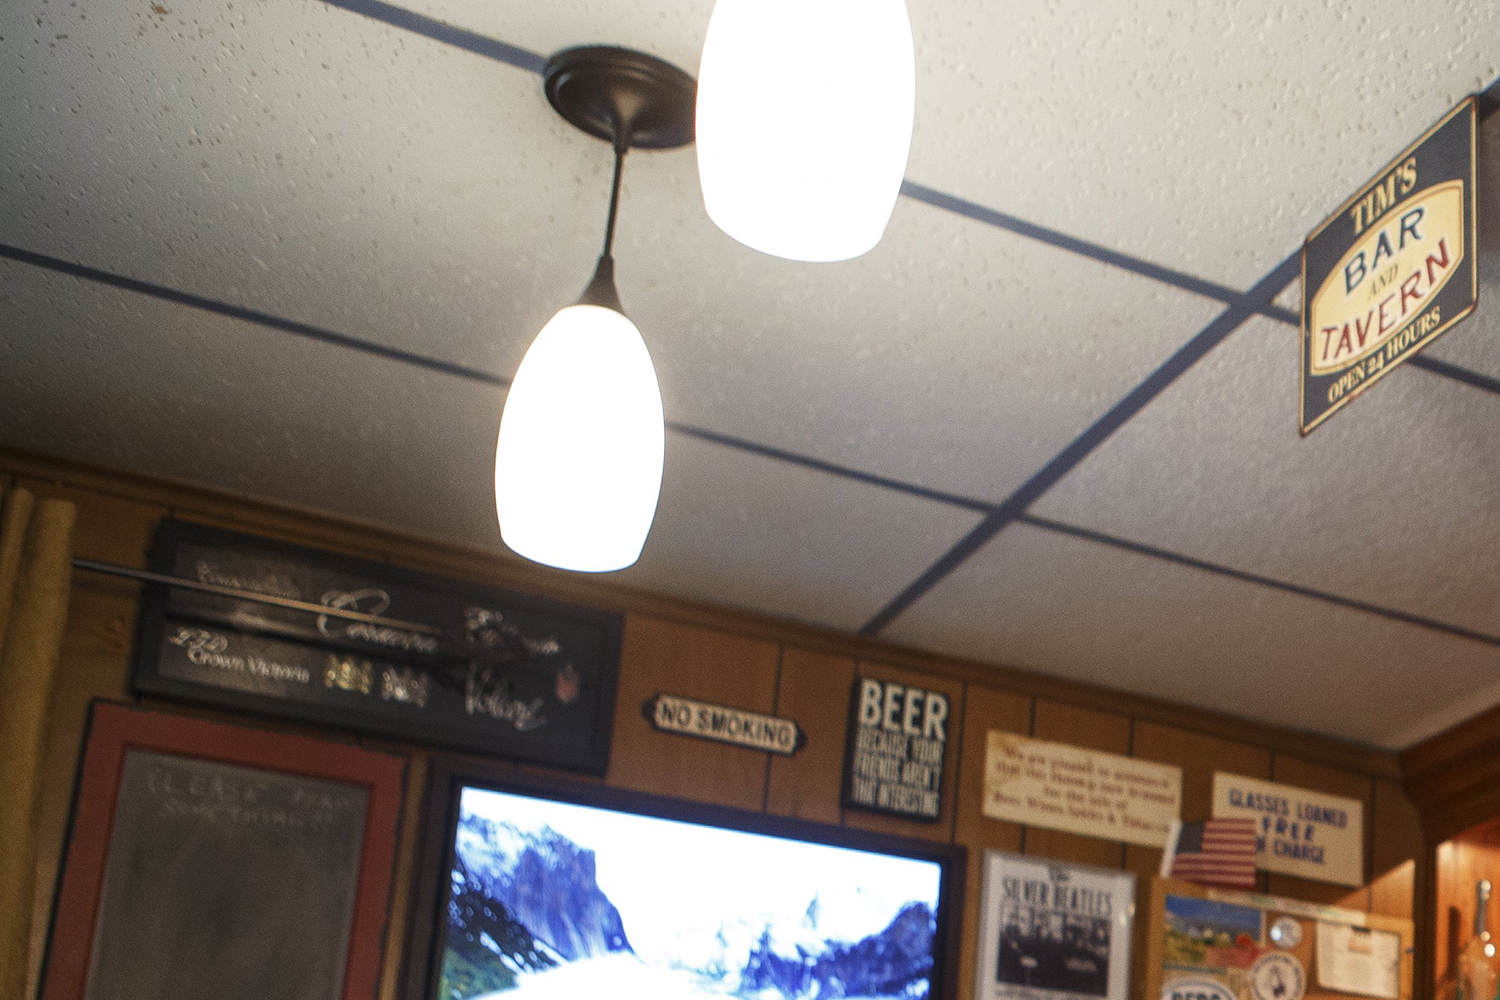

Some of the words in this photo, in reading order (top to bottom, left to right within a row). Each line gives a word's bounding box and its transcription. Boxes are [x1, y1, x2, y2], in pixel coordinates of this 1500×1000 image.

[1351, 156, 1417, 236] TIM'S
[1344, 206, 1424, 292] BAR
[1321, 237, 1452, 361] TAVERN
[1368, 264, 1399, 299] AND
[1327, 360, 1365, 403] OPEN
[1367, 356, 1385, 378] 24
[1386, 305, 1441, 362] HOURS
[187, 648, 245, 672] Crown
[247, 656, 310, 684] Victoria
[659, 702, 692, 725] NO
[698, 709, 792, 747] SMOKING
[860, 678, 949, 742] BEER
[857, 726, 909, 759] BECAUSE
[914, 737, 944, 764] YOUR
[853, 775, 877, 806] THAT
[1228, 788, 1290, 817] GLASSES
[1002, 876, 1049, 905] SILVER
